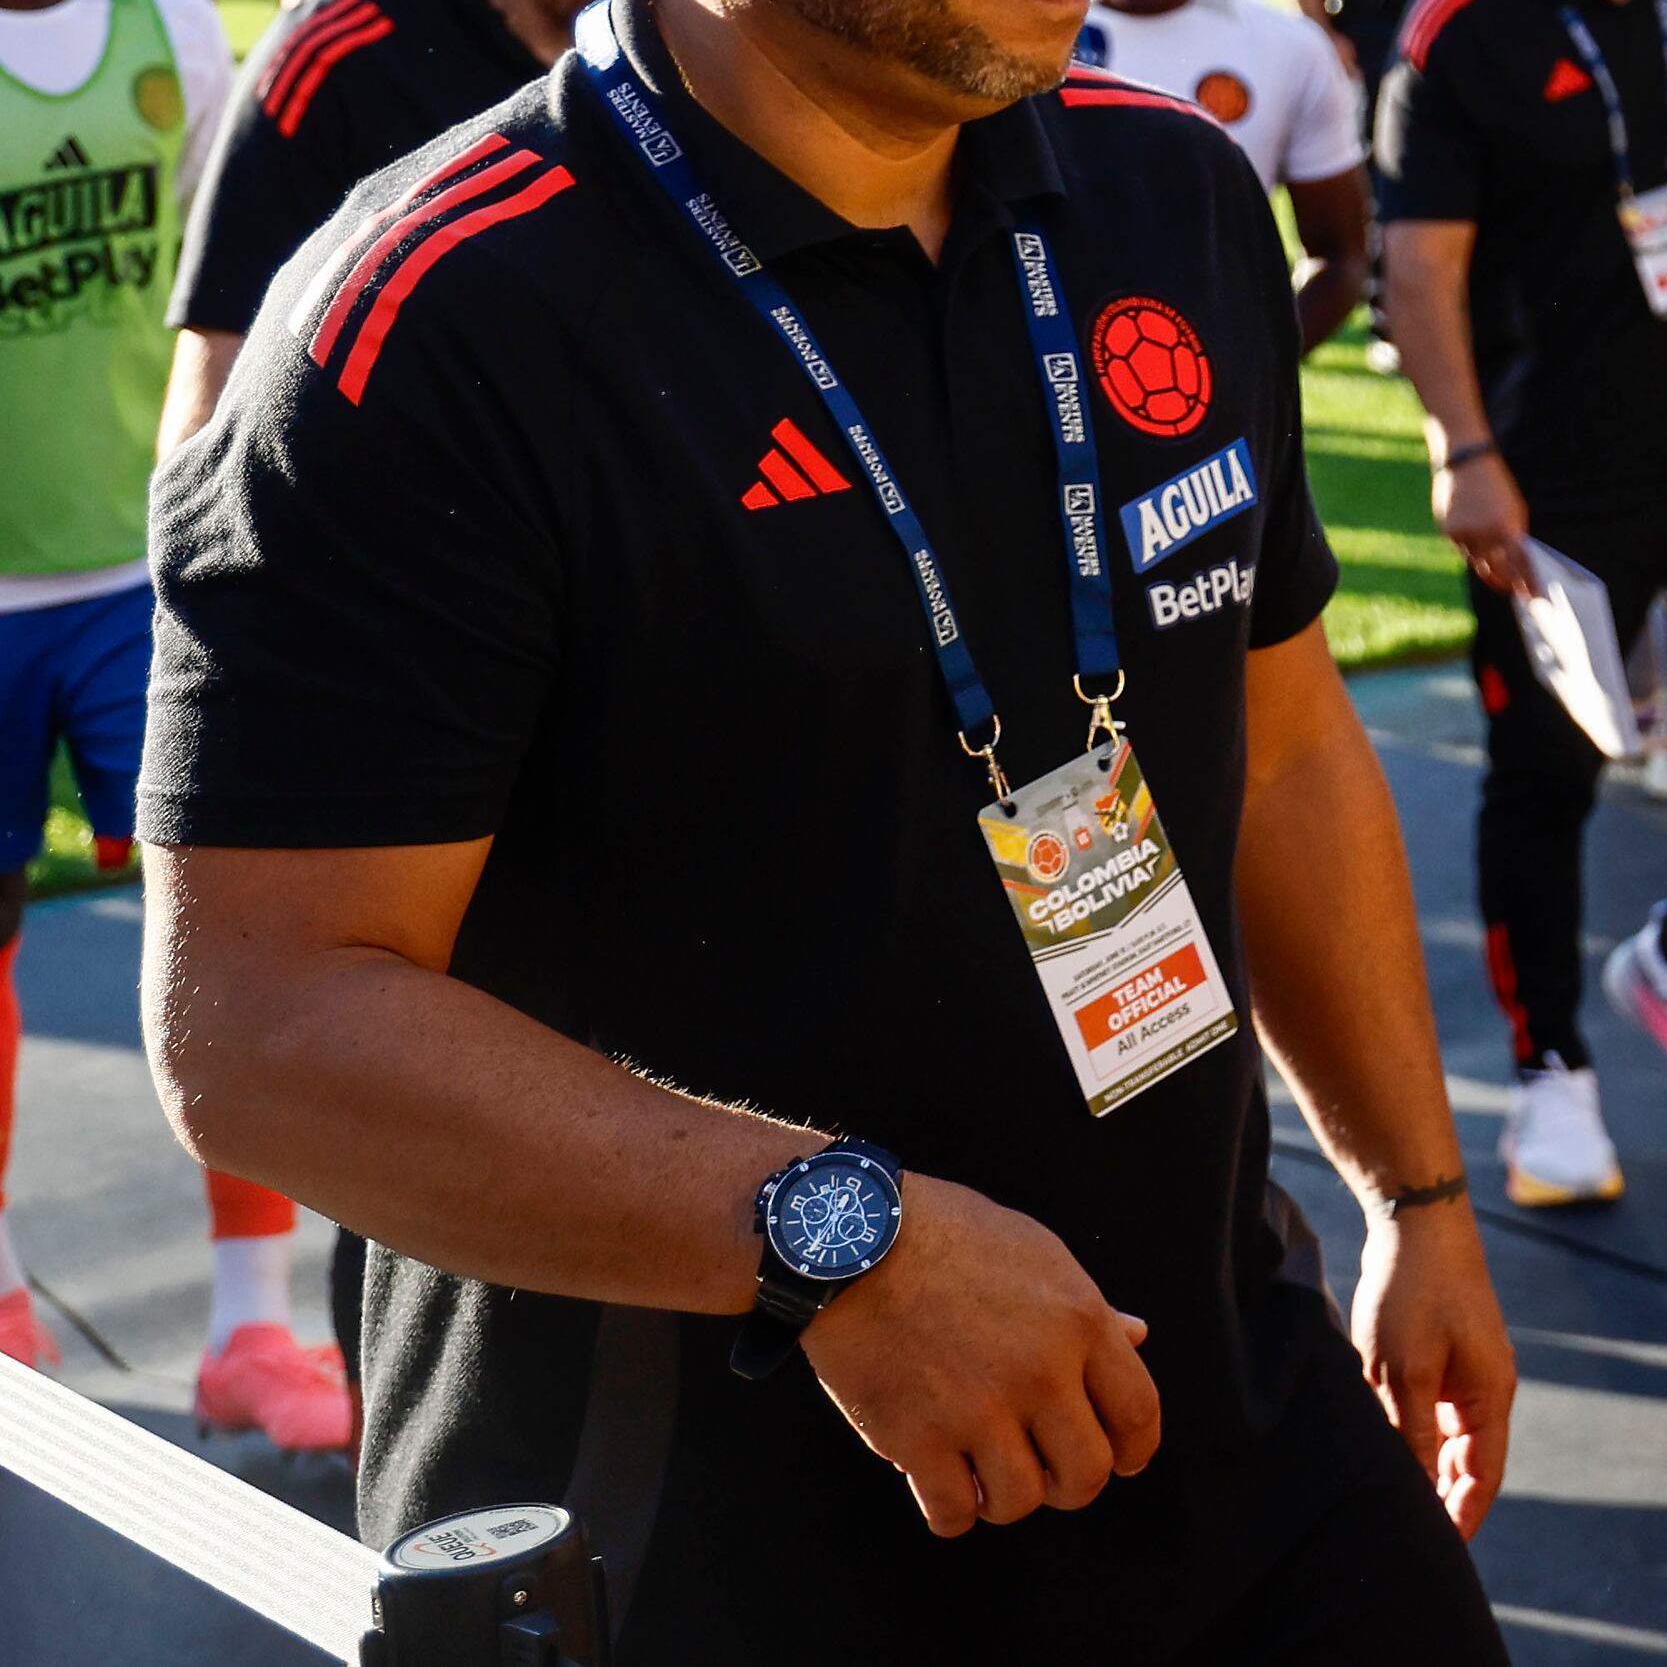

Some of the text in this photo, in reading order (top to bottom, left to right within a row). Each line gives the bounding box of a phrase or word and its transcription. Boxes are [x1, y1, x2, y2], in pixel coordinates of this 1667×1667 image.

[606, 88, 648, 139] MASTERS
[618, 82, 662, 136] EVENTS
[1137, 448, 1254, 565] AGUILA
[1028, 837, 1161, 922] COLOMBIA
[1055, 869, 1152, 934] BOLIVIA
[1107, 975, 1188, 1031] OFFICIAL
[1111, 967, 1164, 1007] TEAM
[1117, 1002, 1191, 1055] All Access
